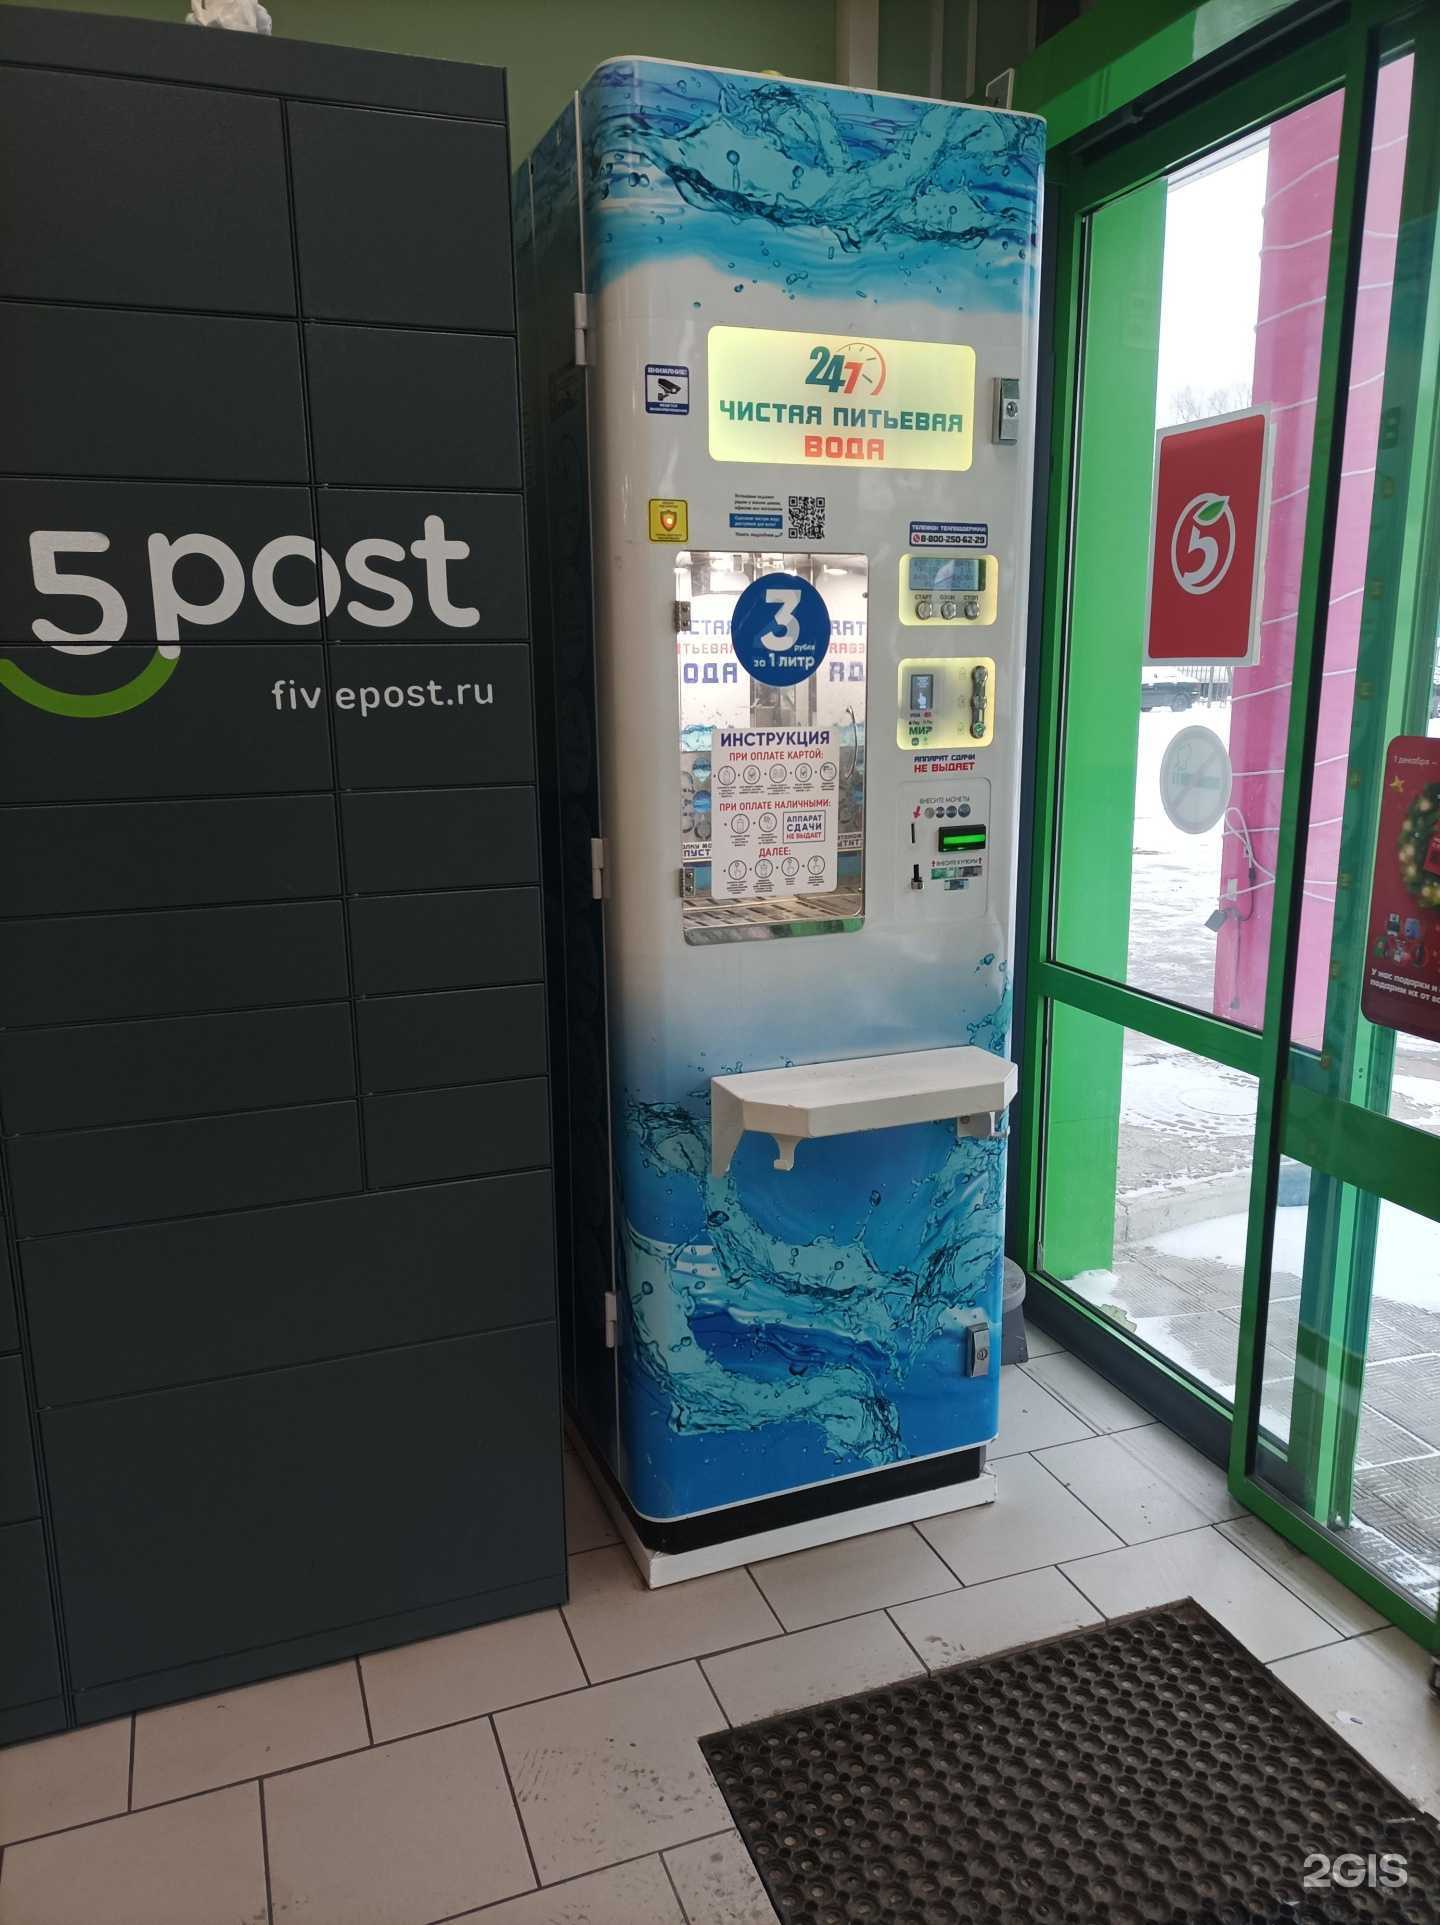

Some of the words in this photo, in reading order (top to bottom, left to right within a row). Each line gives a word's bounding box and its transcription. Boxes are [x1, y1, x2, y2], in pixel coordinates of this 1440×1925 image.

[720, 400, 822, 425] ЧИСТАЯ
[833, 408, 963, 432] ПИТЬЕВАЯ
[804, 436, 884, 461] ВОДА
[920, 534, 986, 544] 8-800-250-62-29
[29, 514, 481, 660] 5post
[760, 588, 802, 652] 3
[753, 658, 766, 668] за
[768, 652, 776, 668] 1
[778, 656, 816, 671] литр
[908, 726, 932, 736] МИР
[720, 730, 830, 747] ИНСТРУКЦИЯ
[729, 752, 748, 761] ПРИ
[750, 751, 785, 760] ОПЛАТЕ
[788, 748, 824, 760] КАРТОЙ:
[914, 764, 928, 773] НЕ
[932, 762, 976, 772] ВЫДАЕТ
[720, 803, 737, 812] ПРИ
[740, 801, 772, 811] ОПЛАТЕ
[774, 799, 831, 810] НАЛИЧНЫМИ:
[786, 814, 822, 823] АППАРАТ
[786, 823, 822, 832] СДАЧИ
[758, 846, 792, 858] ДАЛЕЕ:
[1371, 968, 1377, 976] У
[1378, 970, 1392, 980] нас
[1394, 975, 1430, 990] подарки
[1408, 990, 1418, 998] их
